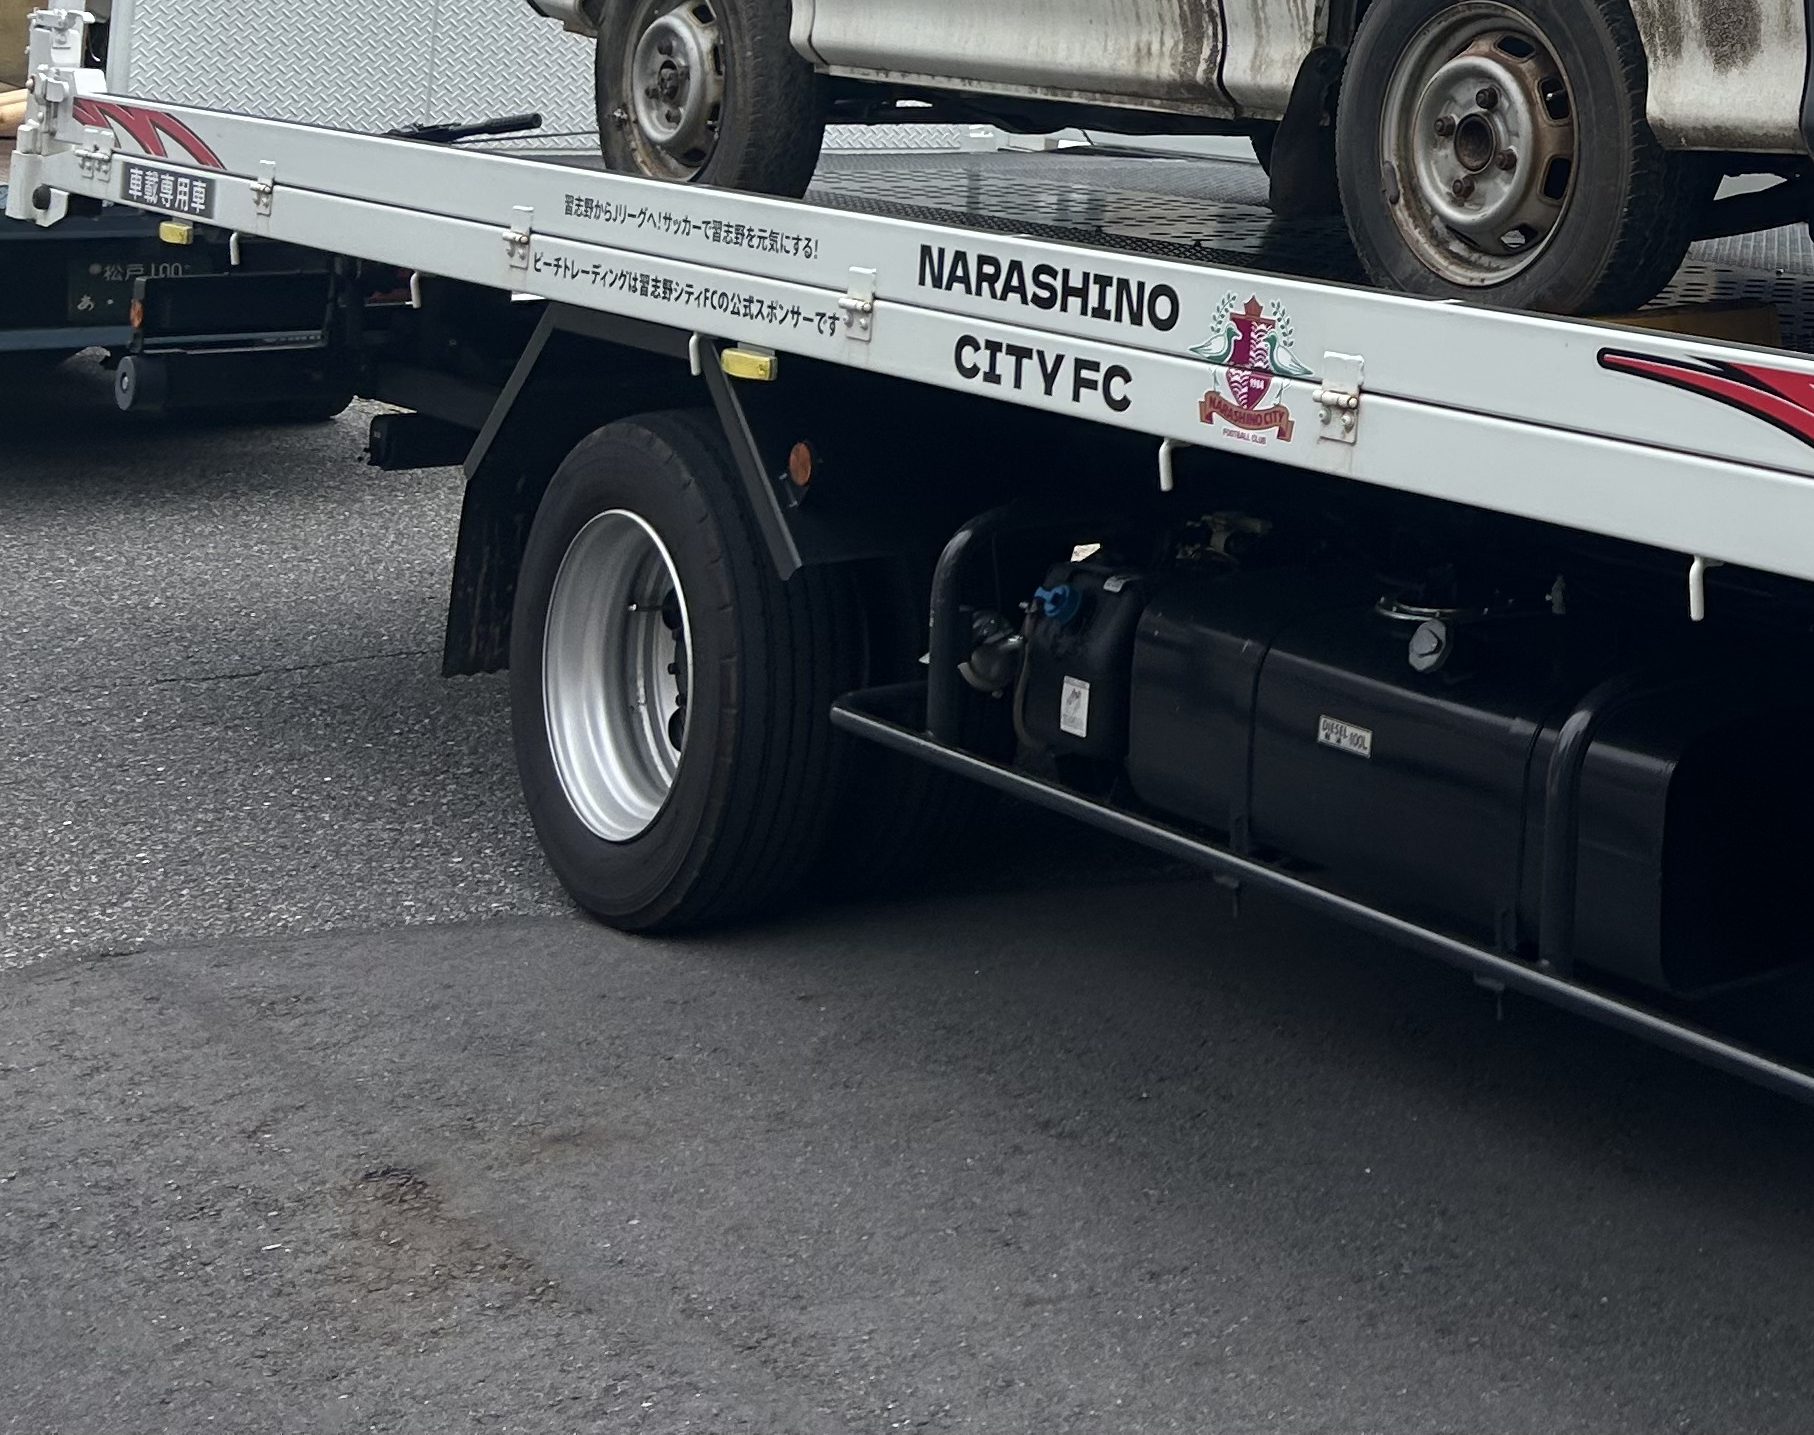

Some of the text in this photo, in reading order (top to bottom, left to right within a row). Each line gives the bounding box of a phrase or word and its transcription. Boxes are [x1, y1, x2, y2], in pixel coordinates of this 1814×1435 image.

[128, 167, 207, 213] 車載専用車
[103, 264, 144, 282] 松戸
[918, 244, 1180, 332] NARASHINO
[954, 334, 1133, 412] CITY FC
[1209, 395, 1284, 426] NARASHINO CITY
